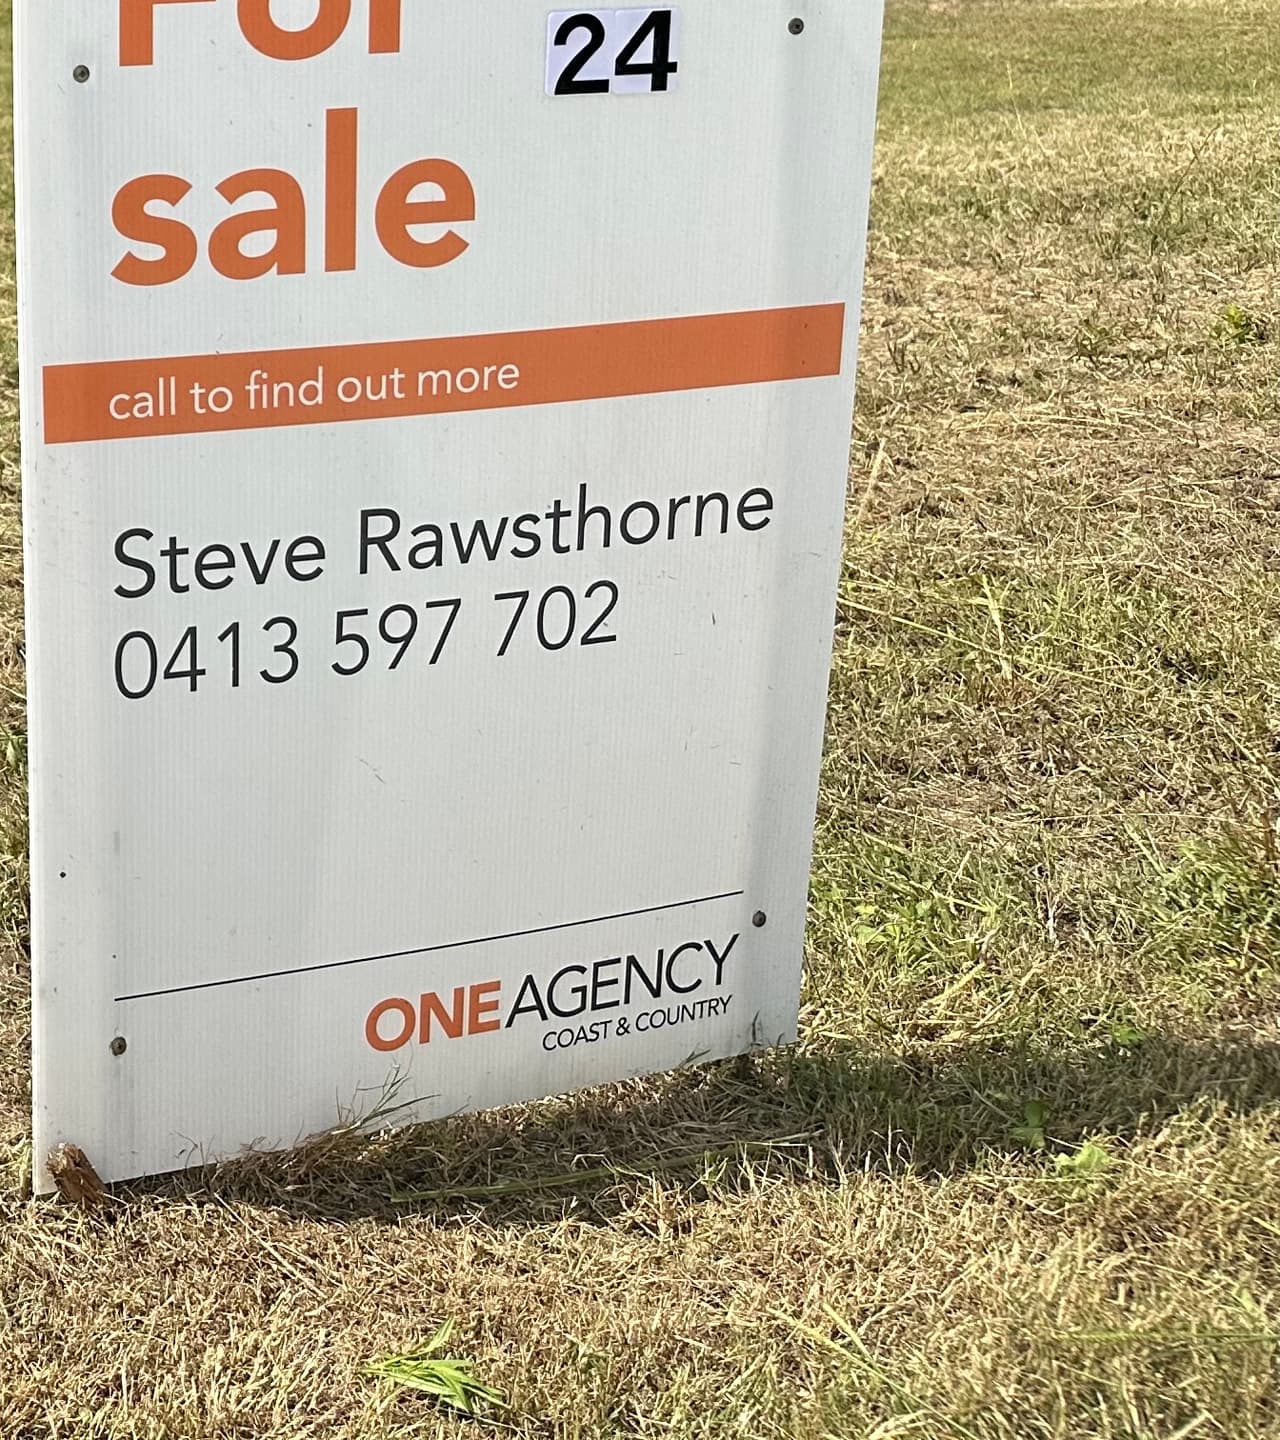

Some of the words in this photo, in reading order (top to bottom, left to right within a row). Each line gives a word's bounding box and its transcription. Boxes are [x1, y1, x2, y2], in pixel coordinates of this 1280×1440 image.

[552, 9, 679, 97] 24
[110, 106, 477, 287] sale
[109, 375, 177, 420] call
[189, 381, 234, 415] to
[244, 365, 325, 411] find
[336, 367, 406, 403] out
[417, 363, 521, 397] more
[113, 527, 327, 600] Steve
[358, 482, 775, 576] Rawsthorne
[113, 608, 300, 701] 0413
[330, 598, 463, 677] 597
[493, 579, 620, 659] 702
[541, 1019, 613, 1052] COAST
[614, 1015, 631, 1037] &
[634, 993, 734, 1033] COUNTRY
